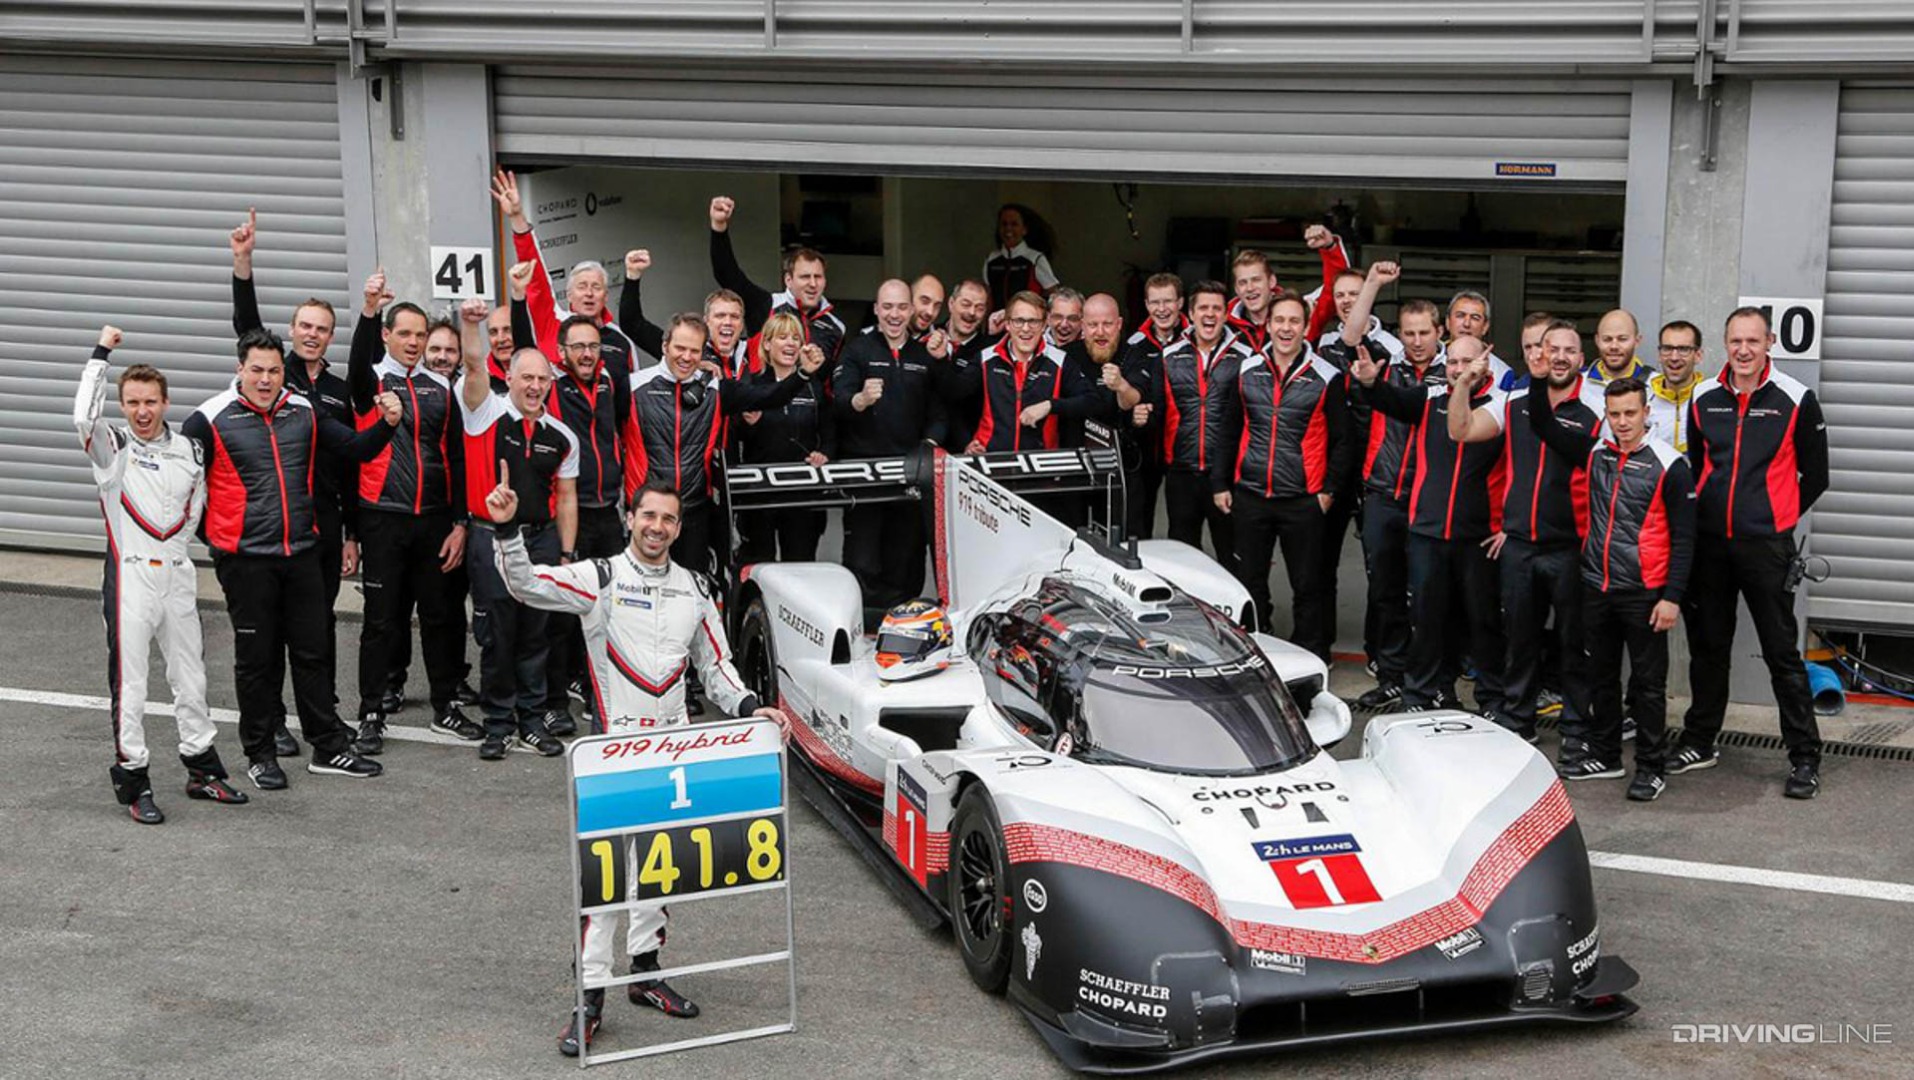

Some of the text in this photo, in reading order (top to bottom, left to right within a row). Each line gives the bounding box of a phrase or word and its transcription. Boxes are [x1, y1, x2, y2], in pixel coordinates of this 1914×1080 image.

[436, 253, 484, 294] 41
[959, 469, 1031, 527] PORSCHE
[959, 491, 998, 533] 919 tribute
[779, 604, 825, 648] SCHAEFFLER
[1112, 655, 1266, 679] PORSCHE
[602, 726, 754, 762] 919 hybrid
[668, 766, 692, 810] 1
[1192, 782, 1336, 801] CHOPARD
[905, 809, 915, 870] 1
[1292, 845, 1311, 854] LE
[1312, 841, 1353, 852] MANS
[591, 819, 782, 902] 141.8
[1026, 884, 1044, 906] Esso
[1295, 858, 1346, 905] 1
[1251, 948, 1306, 967] Mobil 1
[1434, 931, 1469, 951] Mobil
[1078, 986, 1168, 1018] CHOPARD
[1079, 968, 1170, 1000] SCHAEFFLER
